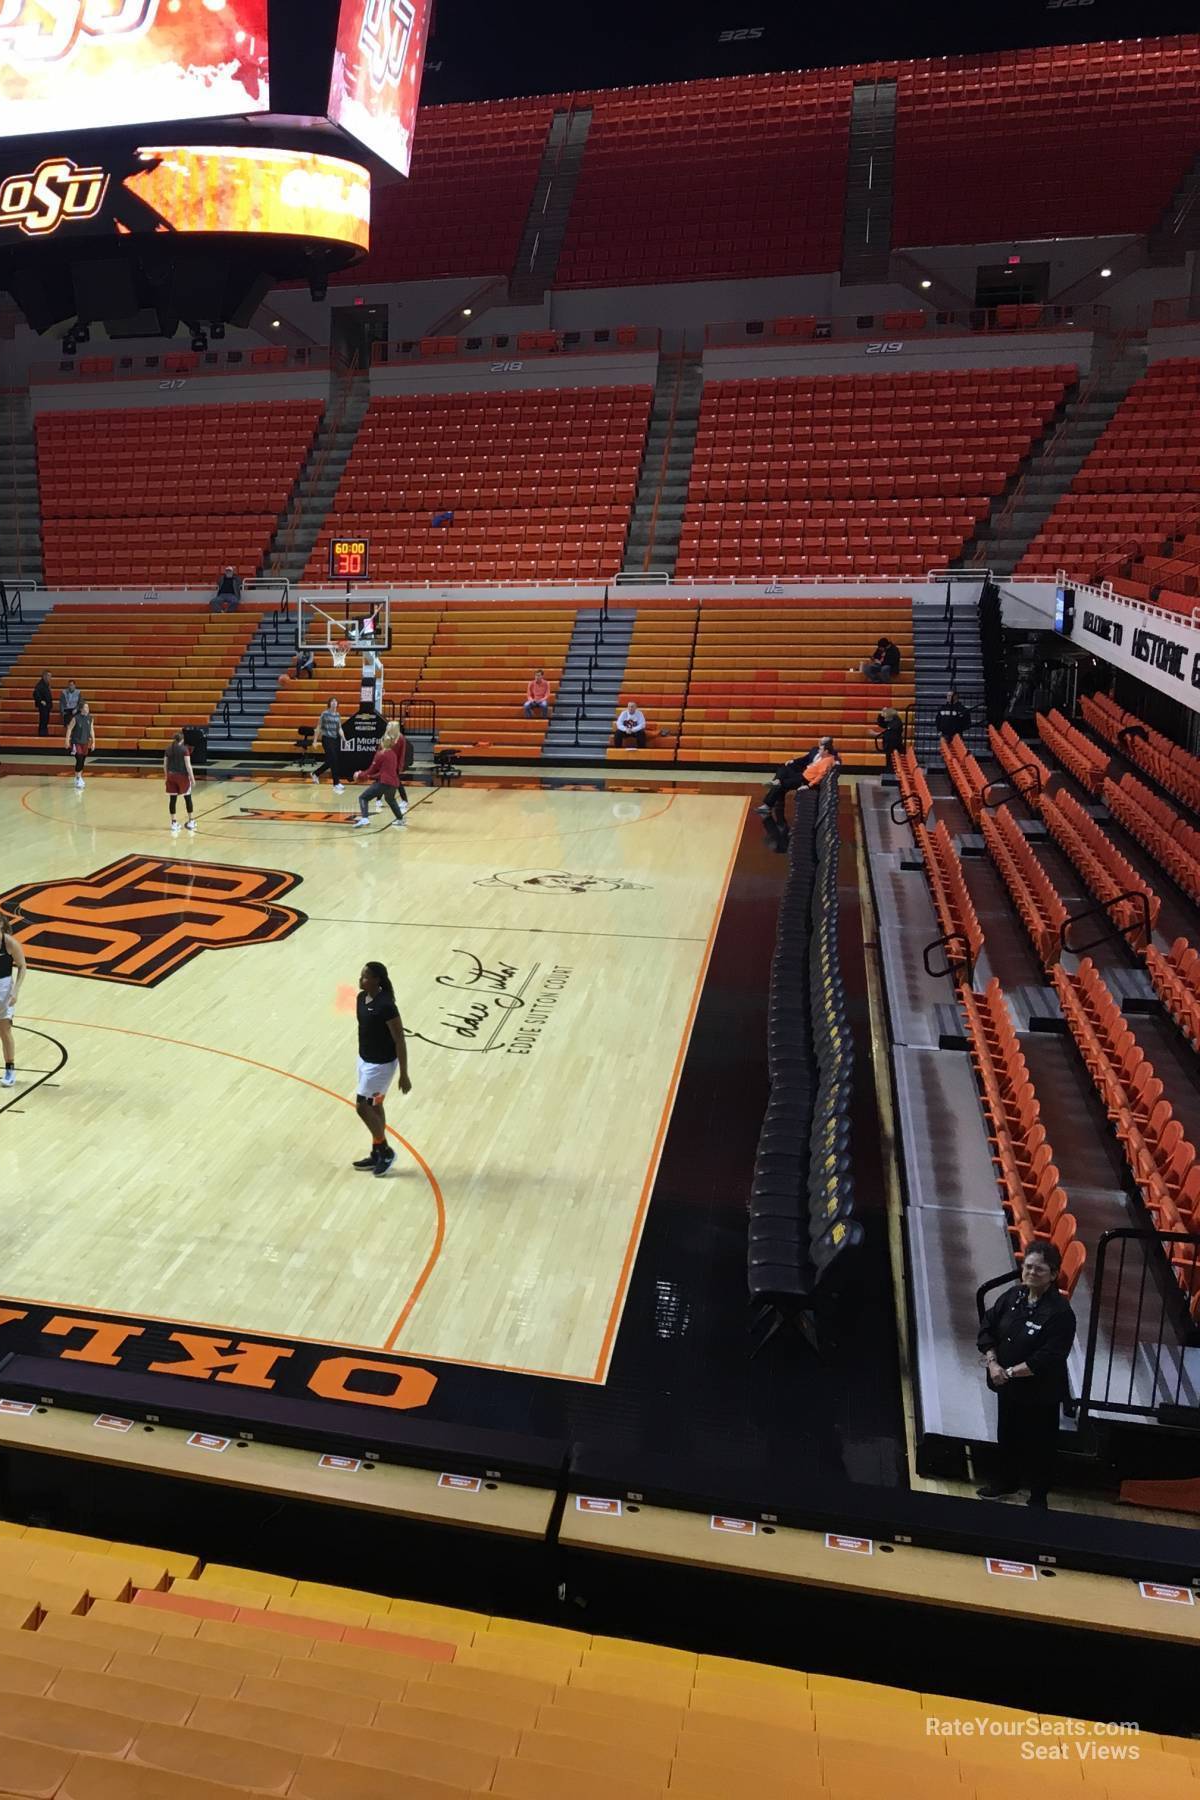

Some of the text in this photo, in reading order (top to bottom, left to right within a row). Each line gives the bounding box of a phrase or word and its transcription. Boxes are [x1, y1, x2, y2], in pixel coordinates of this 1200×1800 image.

[718, 28, 765, 42] 325
[865, 342, 904, 353] 219
[491, 361, 524, 372] 218
[159, 379, 186, 390] 217
[335, 543, 365, 554] 60:00
[339, 554, 362, 574] 30
[1083, 611, 1113, 643] WELCOME
[1112, 619, 1123, 646] TO
[1131, 627, 1189, 681] HISTORIC
[506, 965, 574, 1055] EDDIE SUTTON COURT
